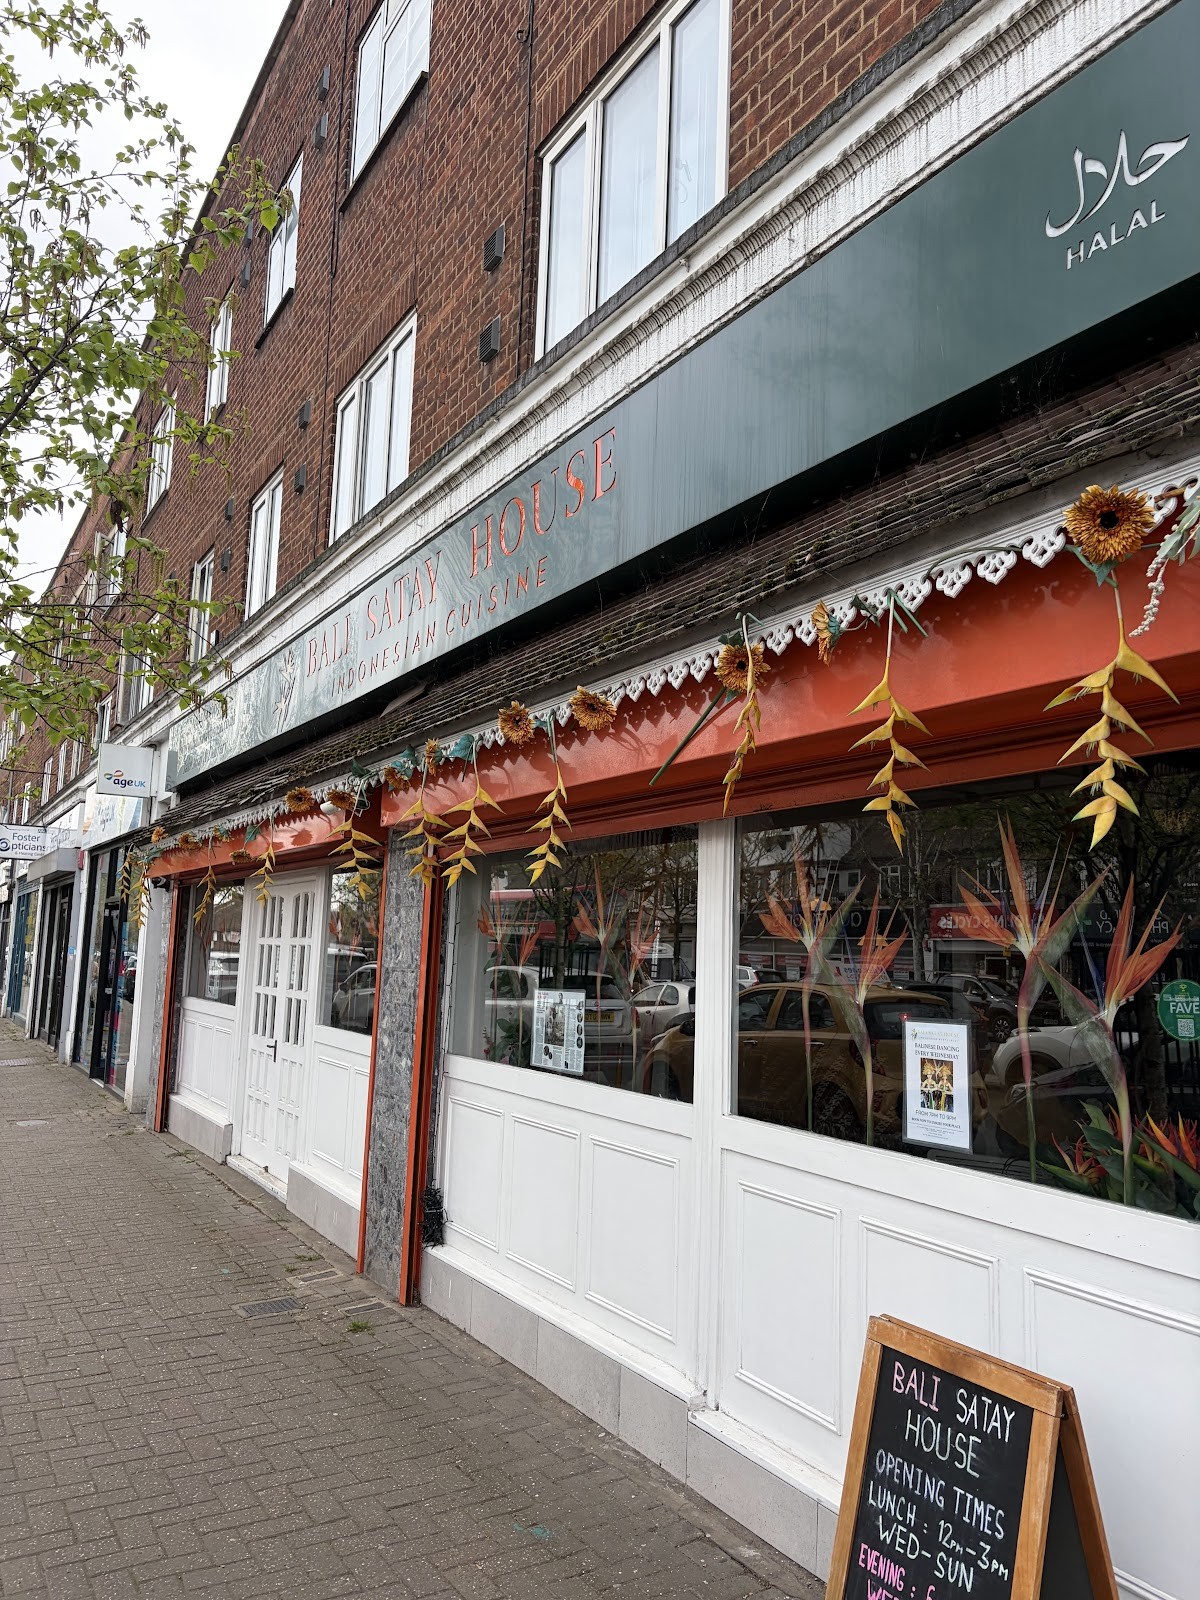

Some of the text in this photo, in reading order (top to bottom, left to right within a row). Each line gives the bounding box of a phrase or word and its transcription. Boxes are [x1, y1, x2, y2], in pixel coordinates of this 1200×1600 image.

[1046, 129, 1190, 237] حلال
[1066, 199, 1165, 270] HALAL
[306, 427, 617, 678] BALI SATAY HOUSE
[331, 556, 548, 697] INDONESIAN CUISINE
[12, 832, 40, 842] Foster
[1169, 1002, 1200, 1014] FAVE
[914, 1049, 960, 1060] EVERY WEDNESDAY
[936, 1045, 960, 1053] DANCING
[892, 1361, 1016, 1443] BALI SATAY
[904, 1409, 982, 1478] HOUSE
[875, 1449, 1005, 1540] OPENING TIMES
